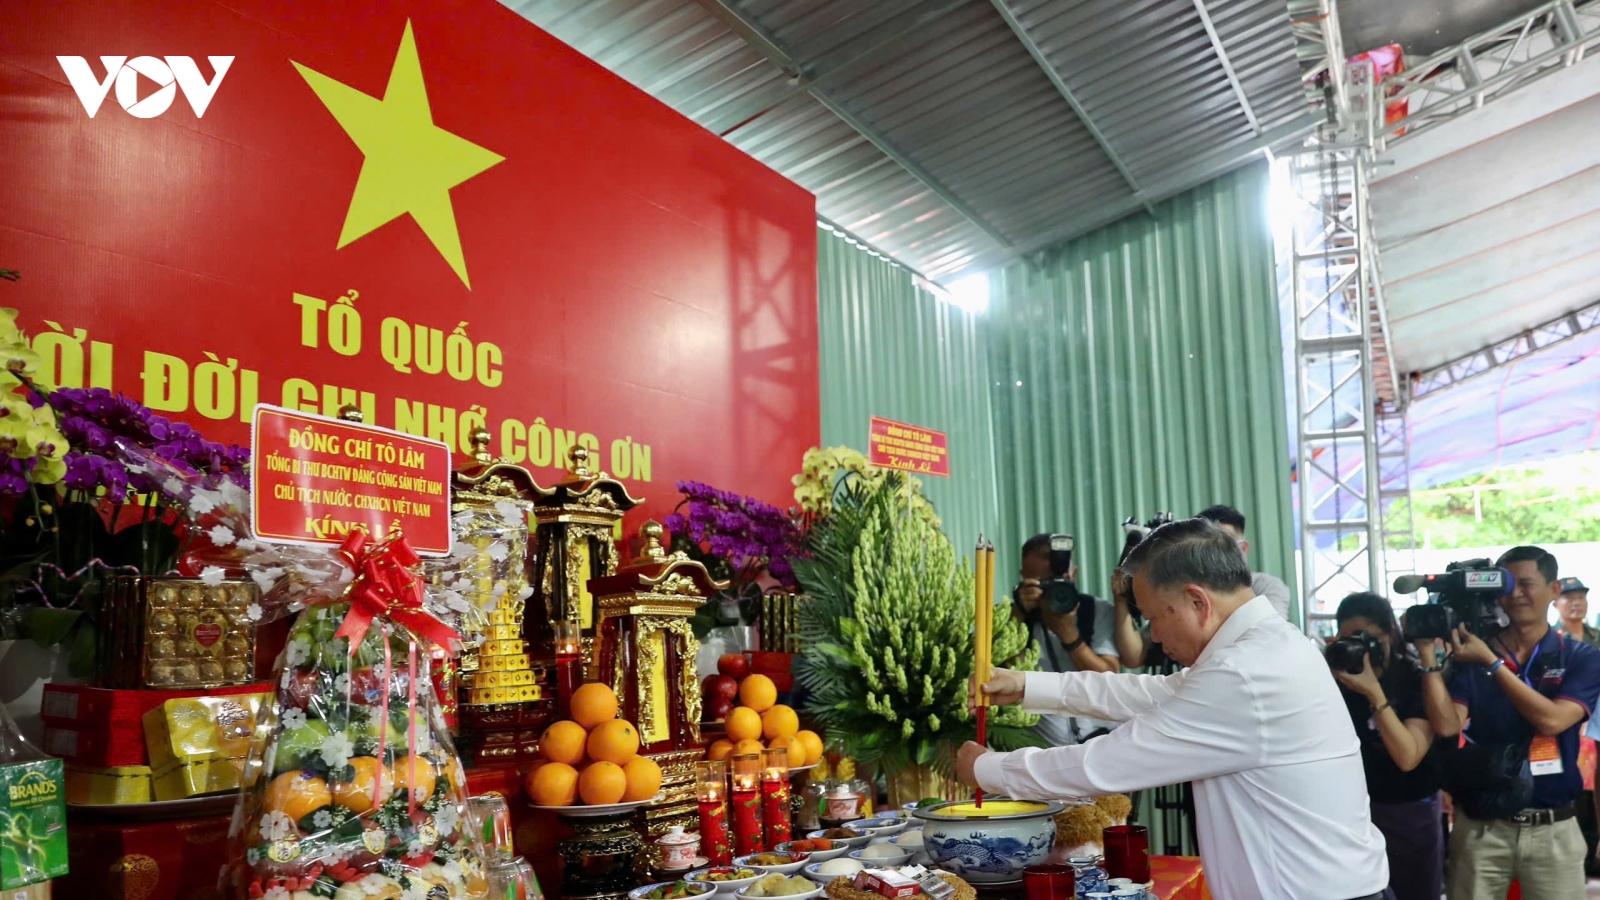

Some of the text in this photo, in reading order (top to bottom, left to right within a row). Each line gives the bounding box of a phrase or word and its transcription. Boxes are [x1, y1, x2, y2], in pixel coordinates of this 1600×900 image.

[293, 289, 503, 388] TỔ QUỐC
[31, 319, 113, 393] ỜI
[140, 351, 258, 424] ĐỜI
[394, 398, 487, 456] NHỚ
[501, 416, 600, 474] CÔNG
[611, 436, 652, 482] ƠN
[289, 425, 425, 470] ĐỒNG CHÍ TÔ LÂM
[266, 449, 443, 496] TỔNG BÍ THƯ BCHTW ĐẢNG CỘNG SẢN VIỆT NAM
[274, 480, 431, 518] CHỦ TỊCH NƯỚC CHXHCN VIỆT NAM
[1469, 572, 1499, 582] HTV
